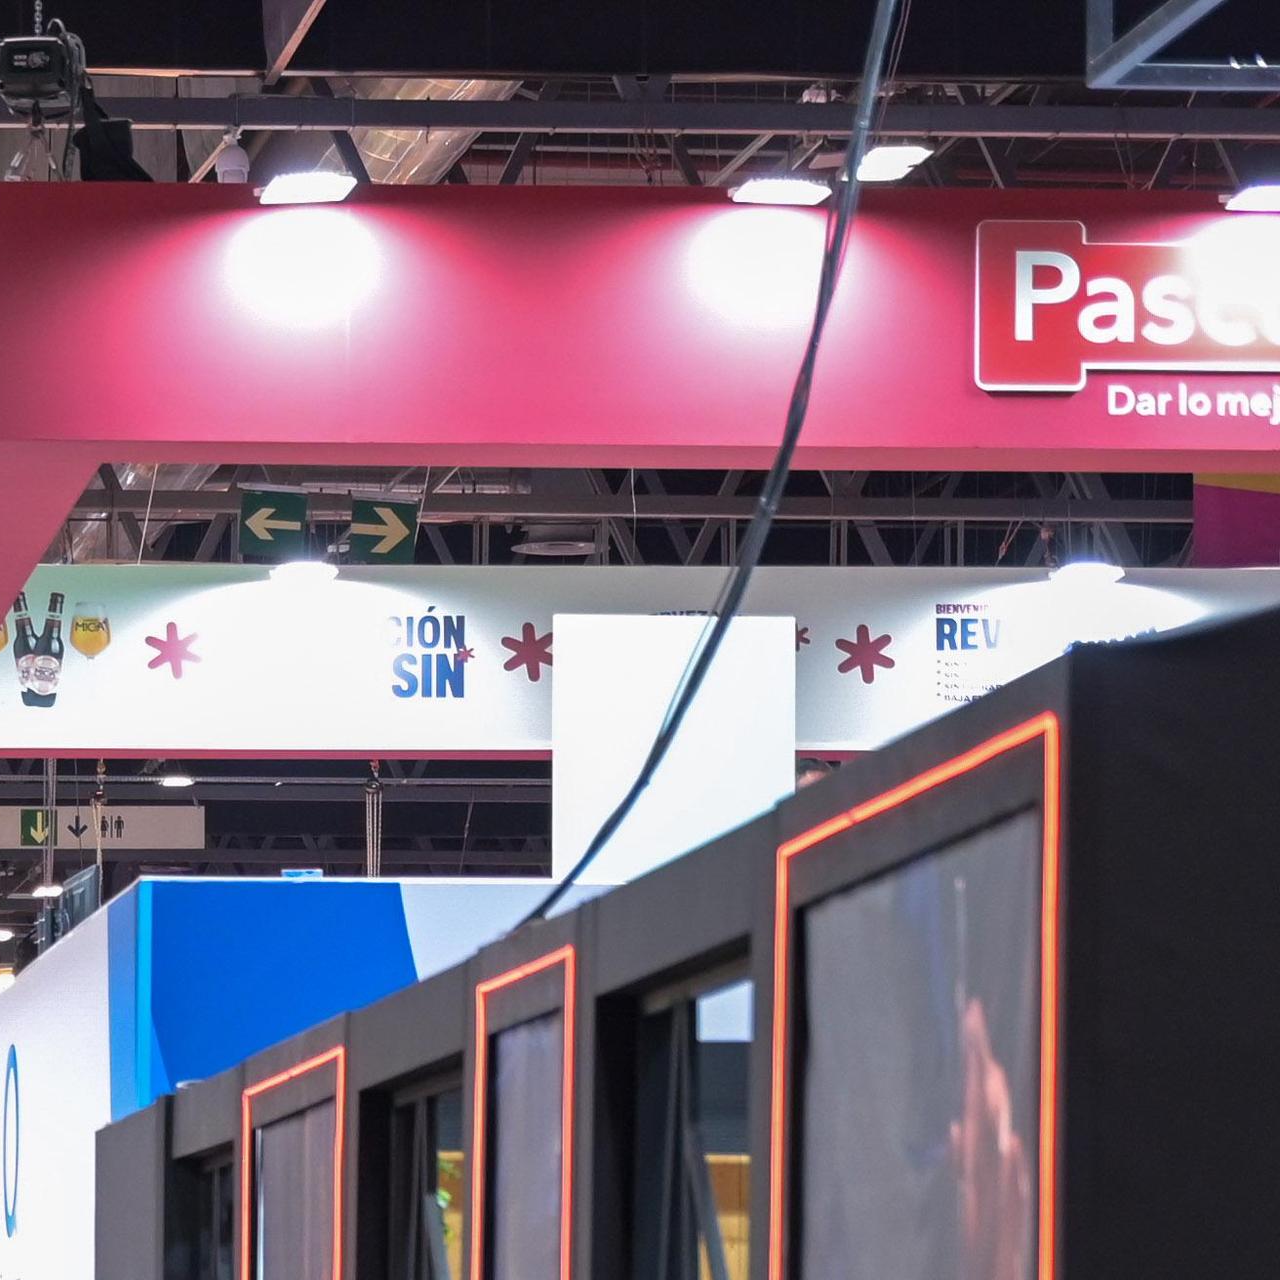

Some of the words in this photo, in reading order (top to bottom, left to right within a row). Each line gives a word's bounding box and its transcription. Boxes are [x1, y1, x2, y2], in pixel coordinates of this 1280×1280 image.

[1014, 250, 1280, 346] Pasc
[1107, 384, 1173, 416] Dar
[1178, 382, 1212, 416] lo
[392, 653, 464, 698] SIN
